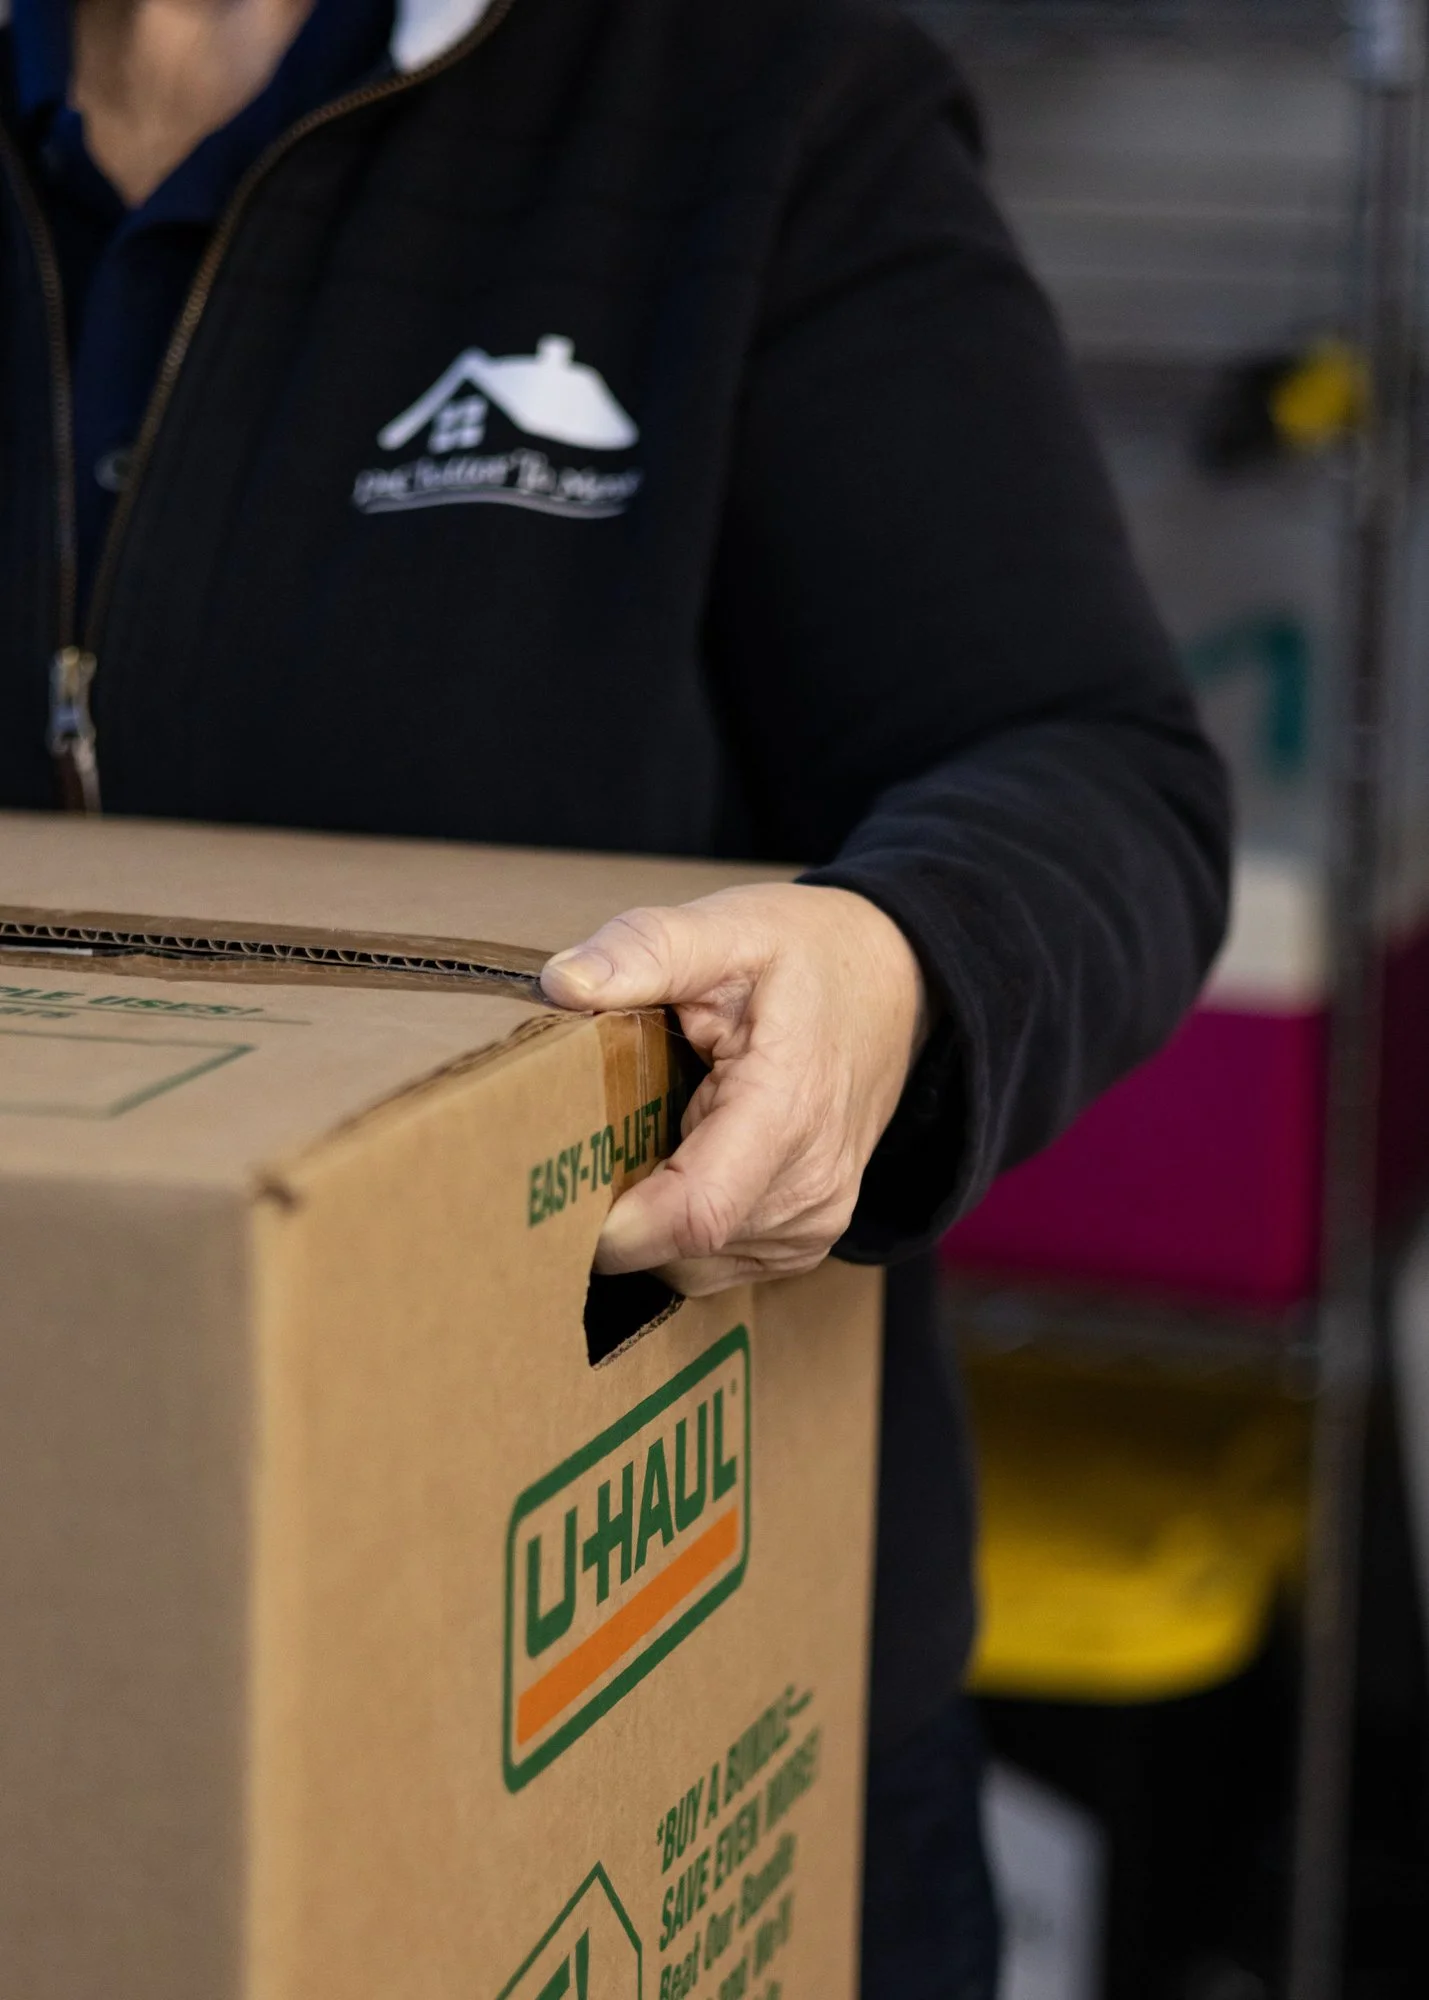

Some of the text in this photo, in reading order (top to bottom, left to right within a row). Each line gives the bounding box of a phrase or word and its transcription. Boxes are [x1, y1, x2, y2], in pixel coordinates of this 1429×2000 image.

[528, 1096, 662, 1229] EASY-TO-LIFT
[525, 1386, 738, 1660] U-HAUL
[704, 1761, 720, 1830] A
[659, 1845, 711, 1953] SAVE
